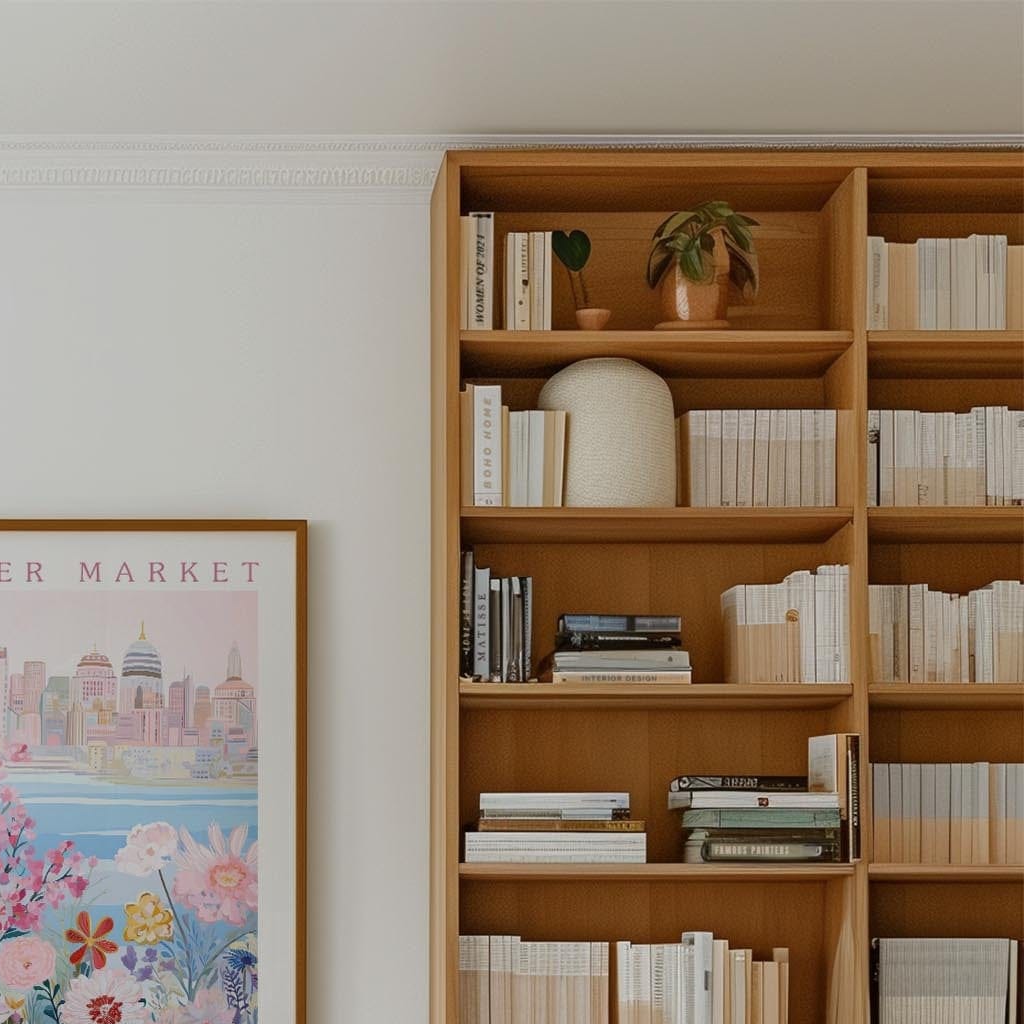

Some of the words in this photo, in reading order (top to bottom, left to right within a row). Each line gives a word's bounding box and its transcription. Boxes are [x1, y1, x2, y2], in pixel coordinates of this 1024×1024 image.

[476, 258, 485, 275] OF
[475, 277, 485, 323] WOMEN
[483, 397, 493, 440] HOME
[483, 447, 493, 489] BOHO
[79, 561, 261, 583] MARKET
[477, 593, 487, 662] MATISSE
[714, 845, 748, 856] FAMOUS
[751, 845, 790, 856] PAINTERS
